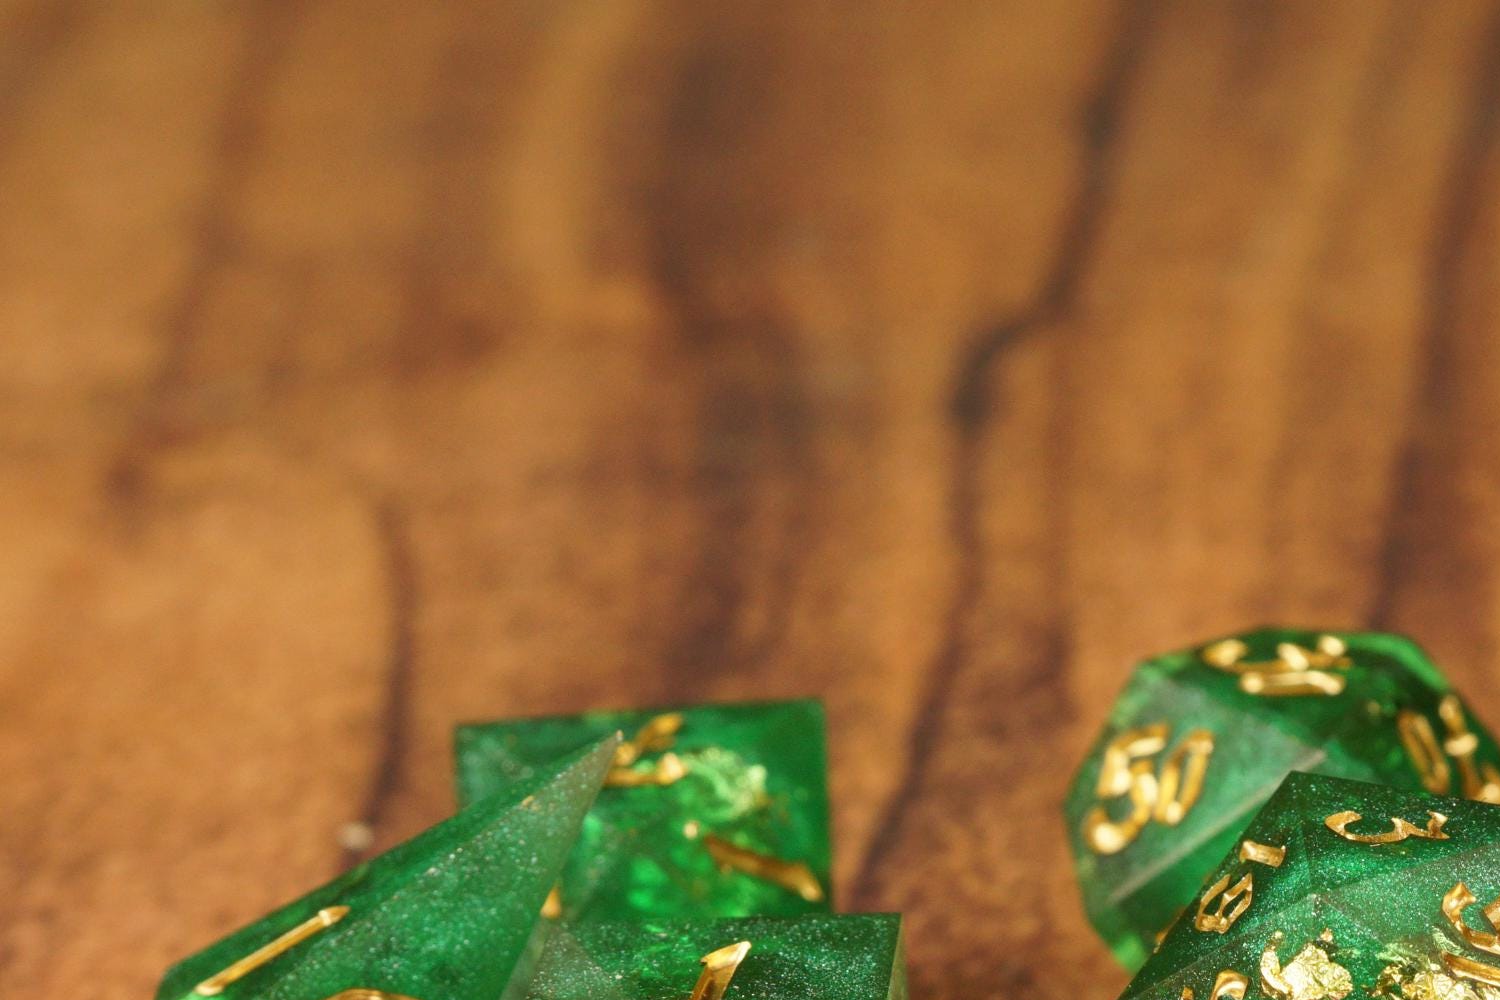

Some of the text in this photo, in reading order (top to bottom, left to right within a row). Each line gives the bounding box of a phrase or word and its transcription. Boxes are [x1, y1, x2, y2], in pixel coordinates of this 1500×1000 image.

[1082, 722, 1214, 856] 50
[1325, 809, 1450, 844] 3
[196, 905, 352, 996] 1
